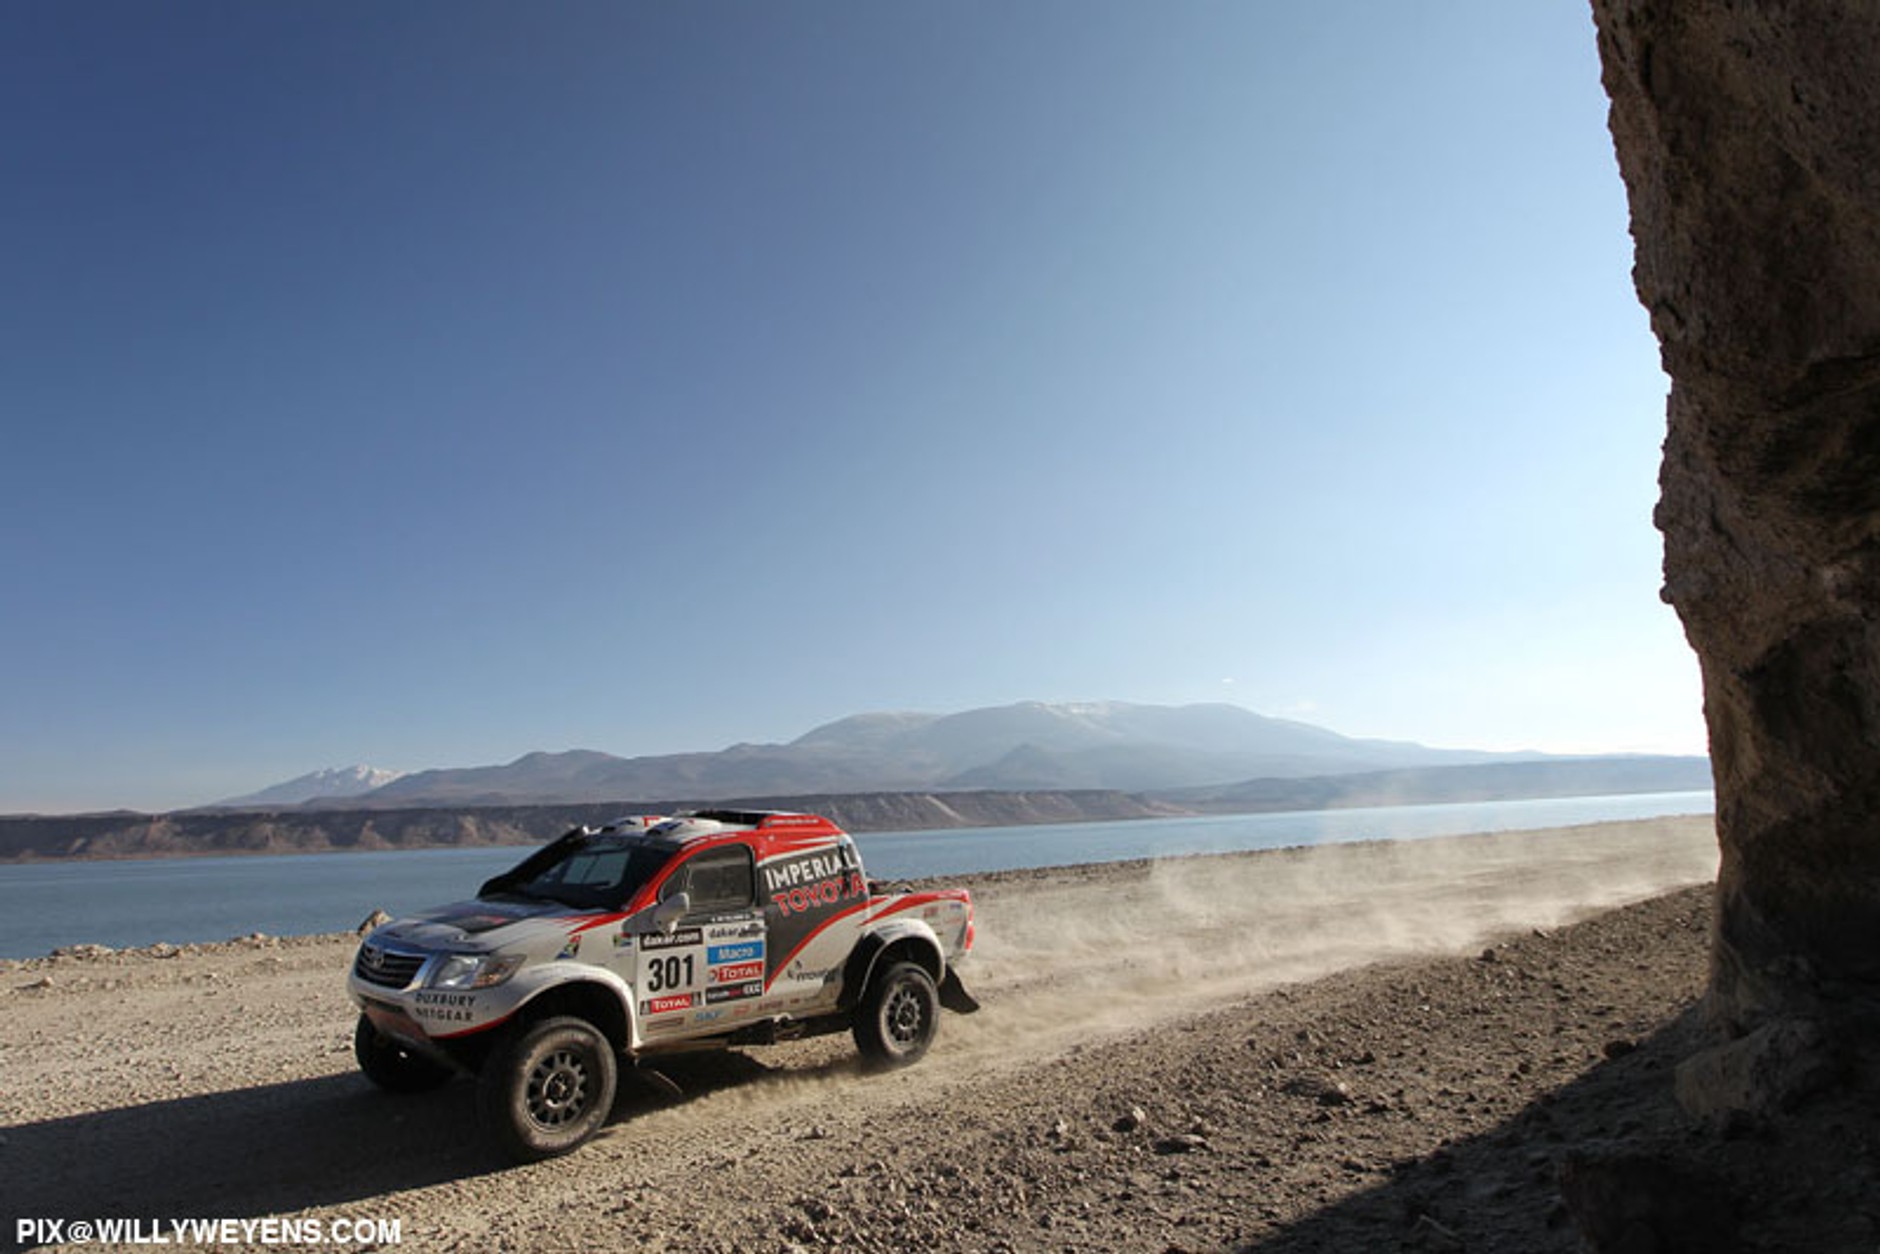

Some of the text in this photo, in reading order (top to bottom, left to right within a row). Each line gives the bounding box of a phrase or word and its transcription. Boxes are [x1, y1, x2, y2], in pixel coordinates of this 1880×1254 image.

[765, 851, 860, 890] IMPERIAL
[772, 875, 867, 917] TOYOTA
[648, 954, 694, 992] 301
[722, 965, 762, 979] TOTAL
[653, 997, 691, 1011] TOTAL
